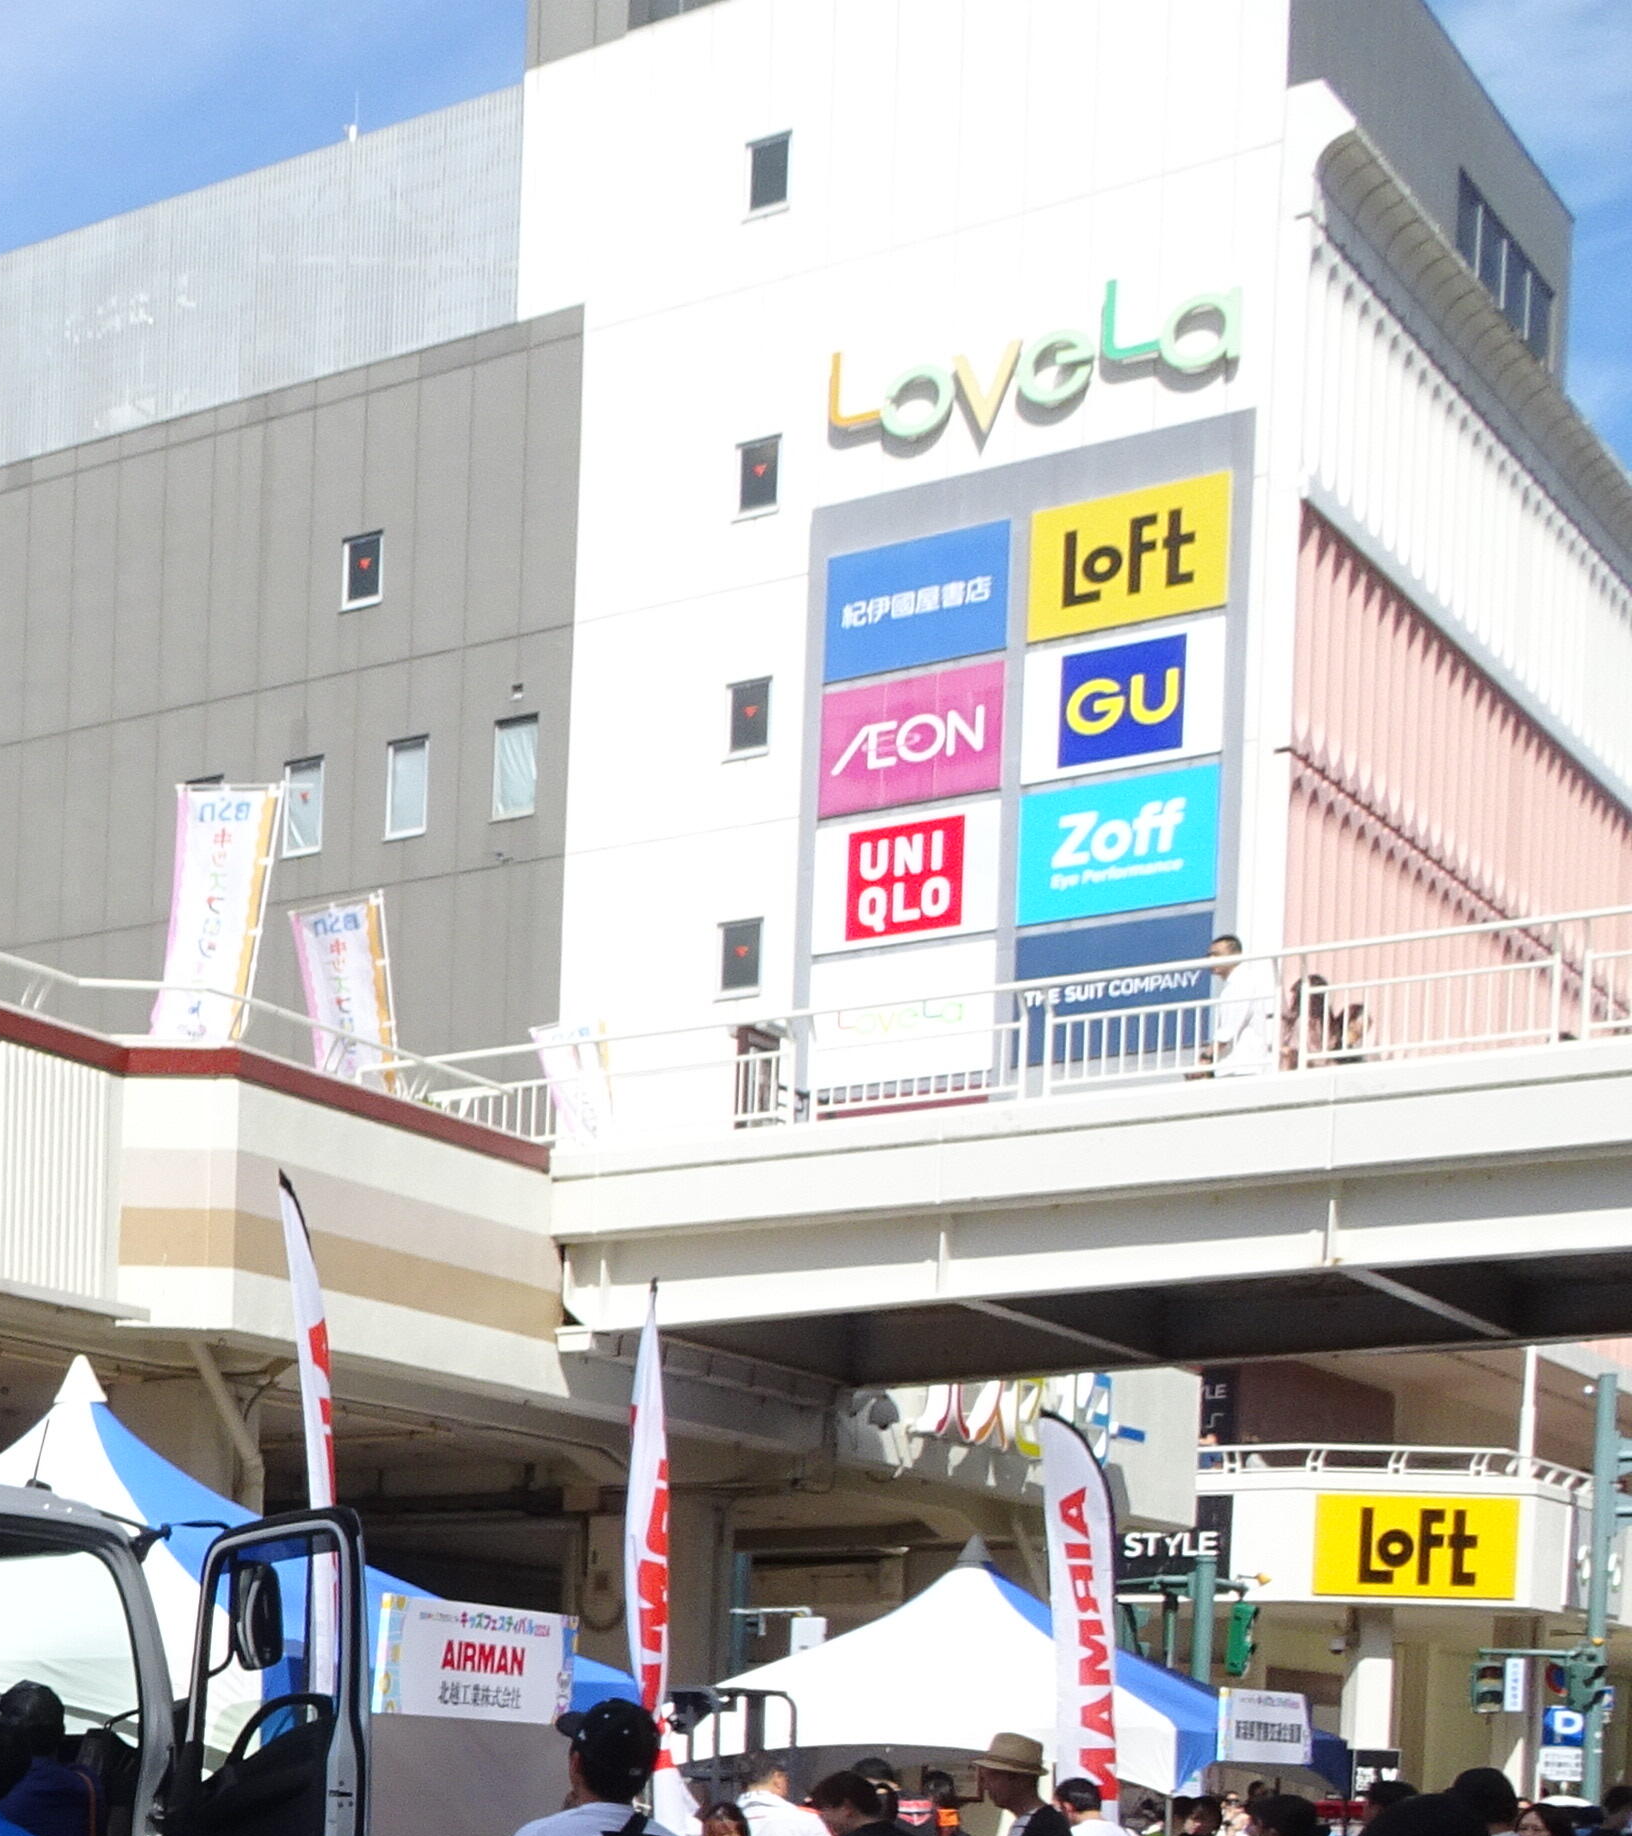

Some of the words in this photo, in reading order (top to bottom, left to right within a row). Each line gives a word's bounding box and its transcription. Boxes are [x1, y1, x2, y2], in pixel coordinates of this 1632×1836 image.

[840, 575, 994, 630] 紀伊國屋書店
[1066, 667, 1180, 737] GU
[859, 829, 944, 881] UNI
[1050, 797, 1188, 870] Zoff
[857, 876, 951, 933] QLO
[1064, 981, 1107, 1003] SUIT
[1108, 969, 1201, 997] COMPANY
[1124, 1531, 1221, 1558] STYLE
[440, 1639, 526, 1676] AIRMAN
[438, 1680, 522, 1710] 北越工業株式会社
